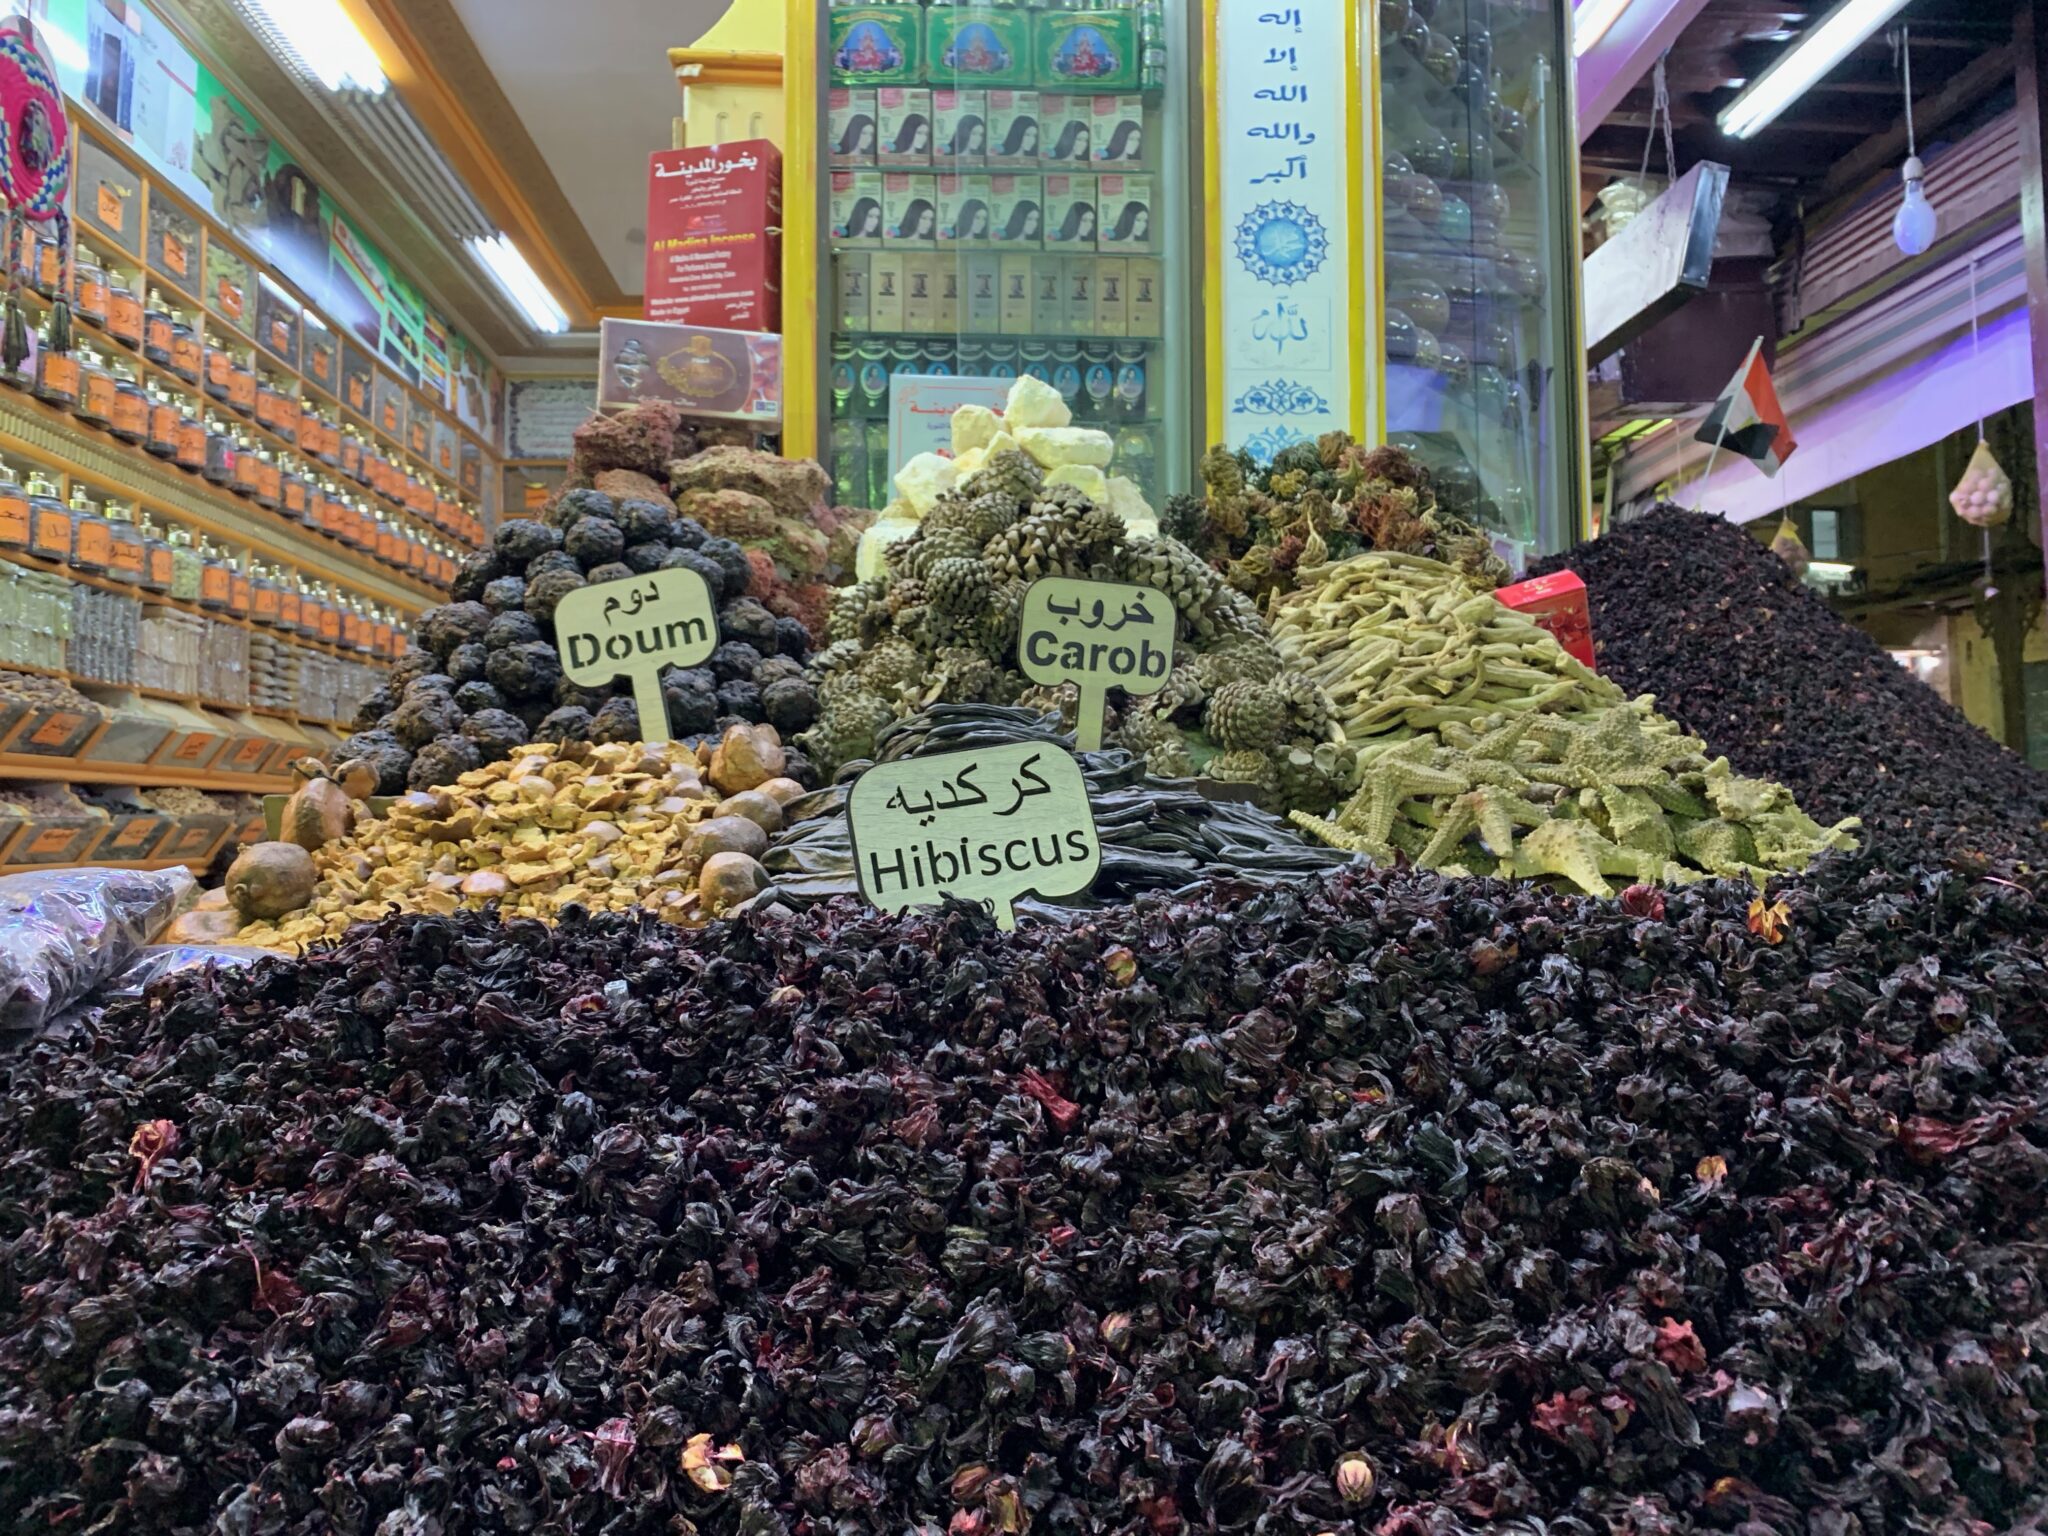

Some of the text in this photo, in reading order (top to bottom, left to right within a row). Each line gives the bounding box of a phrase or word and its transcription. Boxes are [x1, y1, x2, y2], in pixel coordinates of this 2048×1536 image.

[1258, 9, 1302, 33] إله
[1263, 47, 1298, 71] إلا
[1253, 85, 1308, 103] الله
[1247, 123, 1316, 145] والله
[1249, 155, 1308, 184] أكبر
[603, 580, 660, 627] دوم
[1047, 591, 1155, 631] خروب
[567, 617, 708, 669] Doum
[1026, 630, 1166, 678] Carob
[870, 830, 1090, 894] Hibiscus
